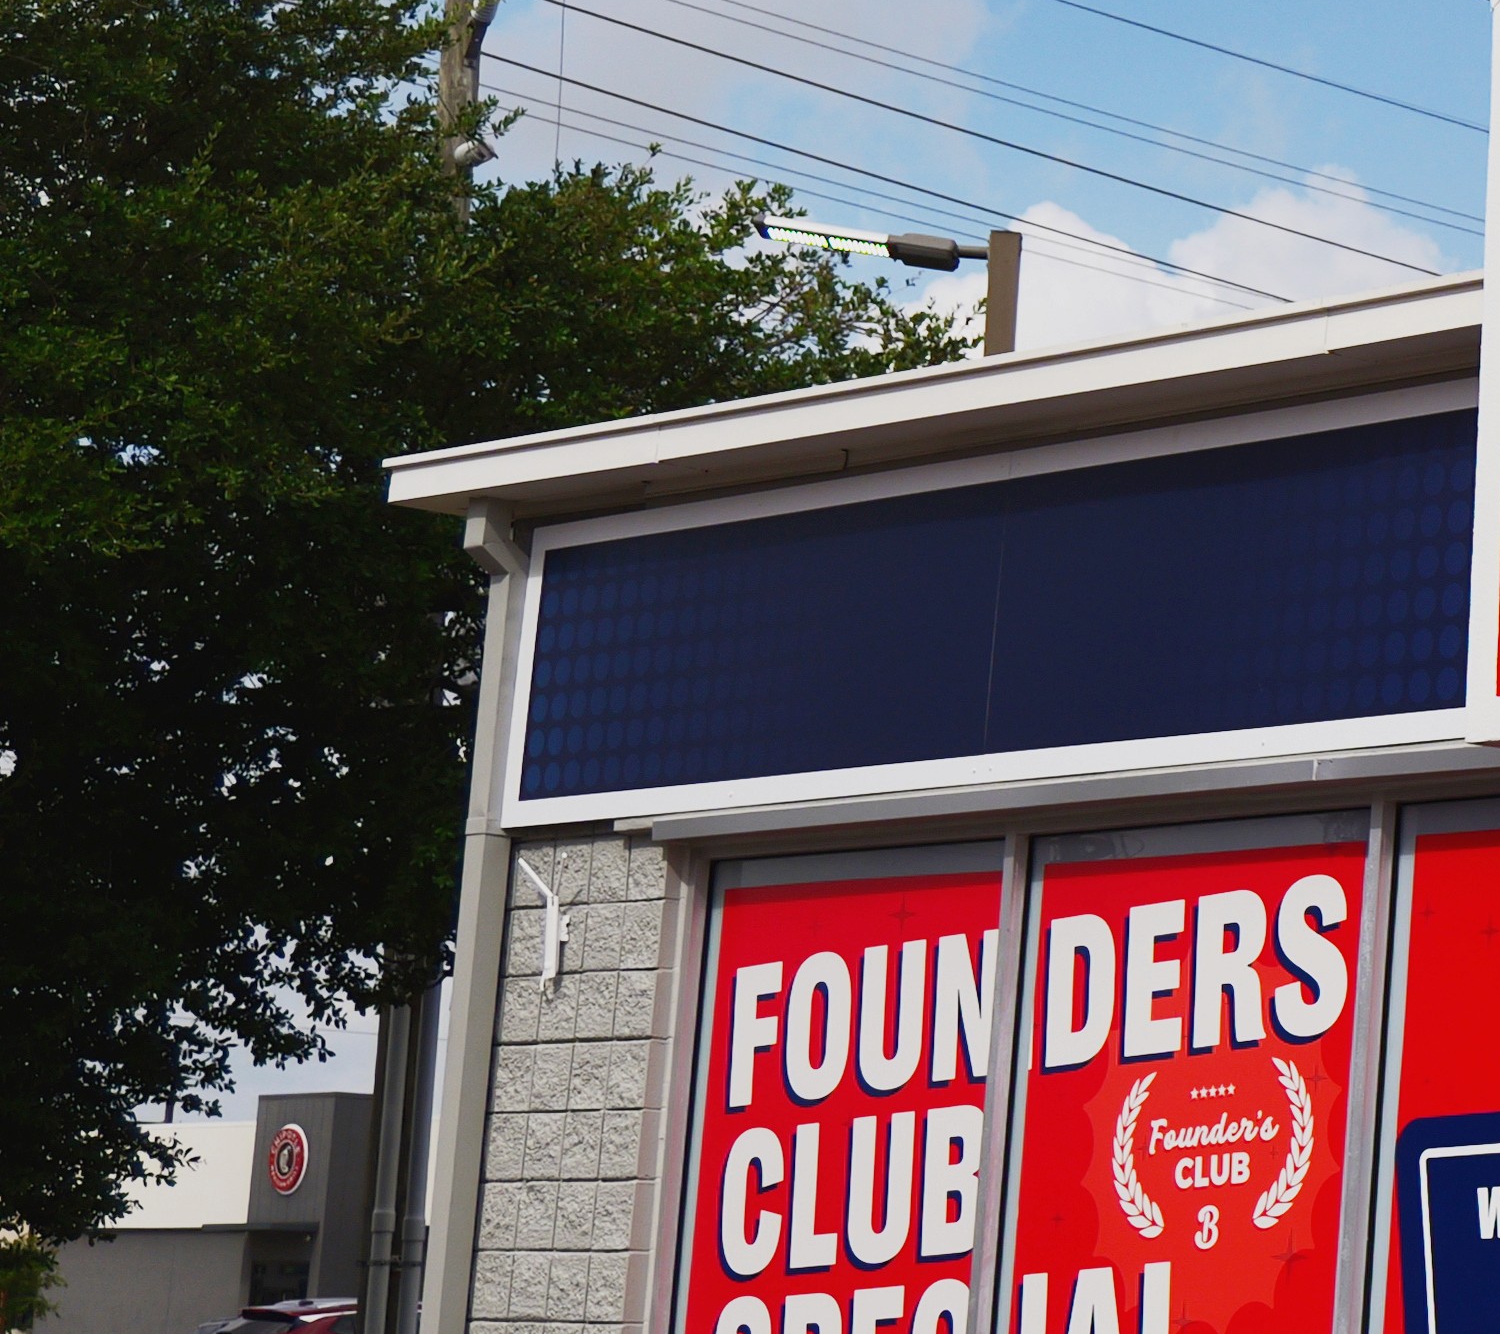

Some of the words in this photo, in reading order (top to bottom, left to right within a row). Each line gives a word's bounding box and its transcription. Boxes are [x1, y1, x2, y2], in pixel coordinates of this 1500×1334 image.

[730, 875, 1348, 1109] FOUNDERS
[1149, 1110, 1280, 1155] Founder's
[1175, 1152, 1251, 1189] CLUB
[722, 1105, 985, 1275] CLUB
